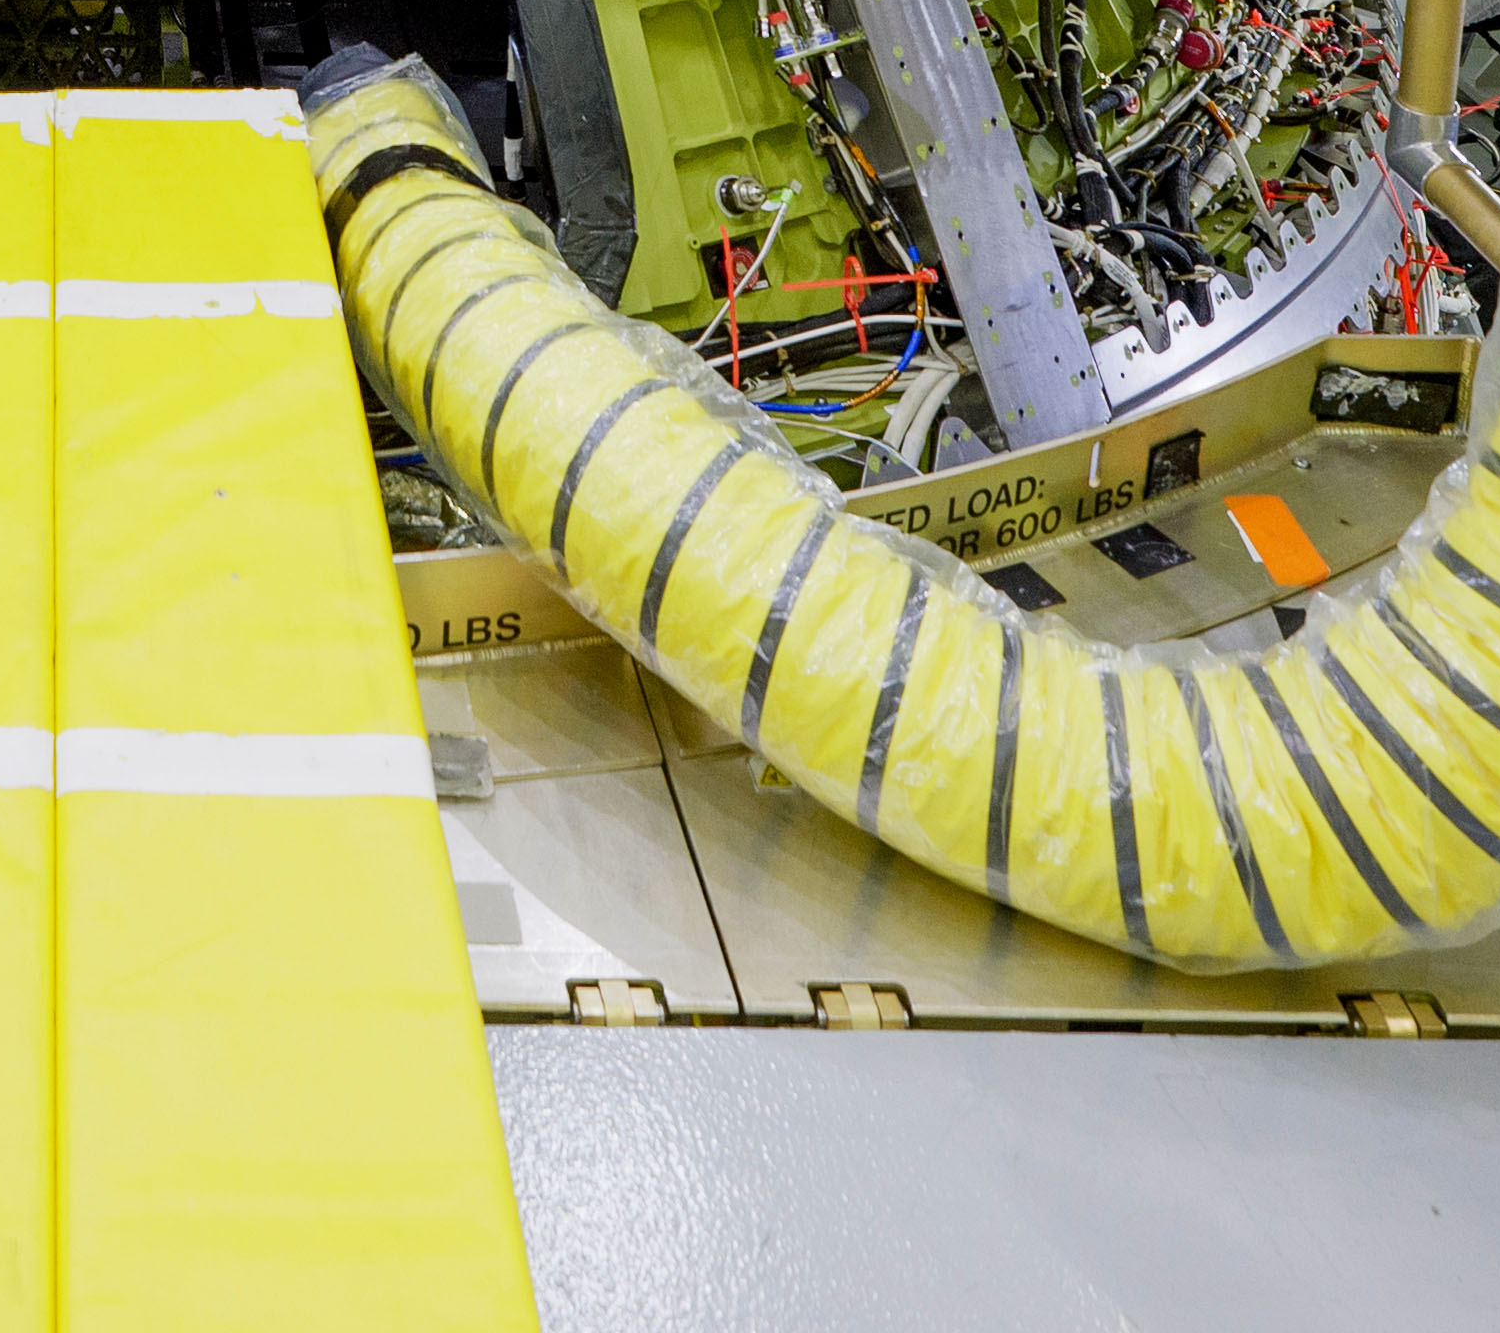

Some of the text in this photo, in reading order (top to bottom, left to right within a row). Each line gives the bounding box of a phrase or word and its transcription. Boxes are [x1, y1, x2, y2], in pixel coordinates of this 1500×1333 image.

[946, 476, 1045, 525] LOAD:
[995, 505, 1062, 549] 600
[1075, 481, 1136, 527] LBS
[441, 611, 523, 644] LBS
